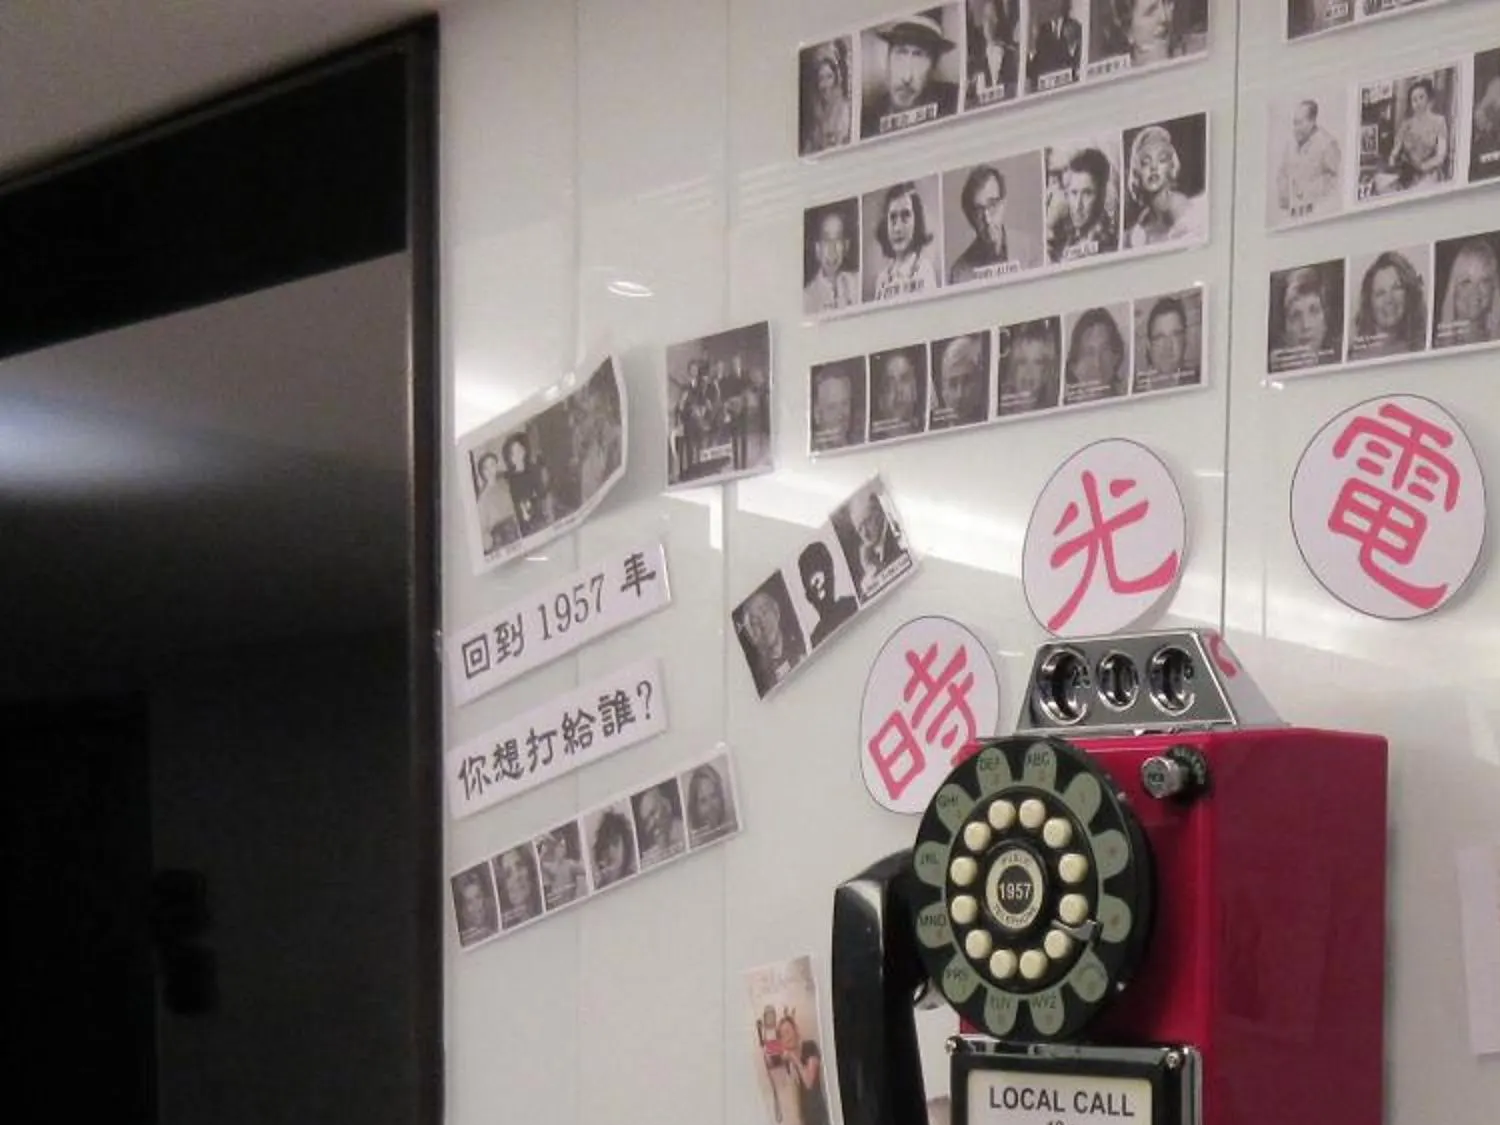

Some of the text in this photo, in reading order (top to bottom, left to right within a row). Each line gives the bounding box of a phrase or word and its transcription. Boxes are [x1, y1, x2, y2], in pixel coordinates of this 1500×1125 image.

[461, 550, 658, 680] 回到 1957 年
[869, 646, 975, 799] 時
[1048, 472, 1178, 631] 光
[1328, 404, 1460, 608] 電
[458, 680, 653, 802] 你想打給誰?
[999, 882, 1031, 901] 1957
[989, 1086, 1135, 1117] LOCAL CALL
